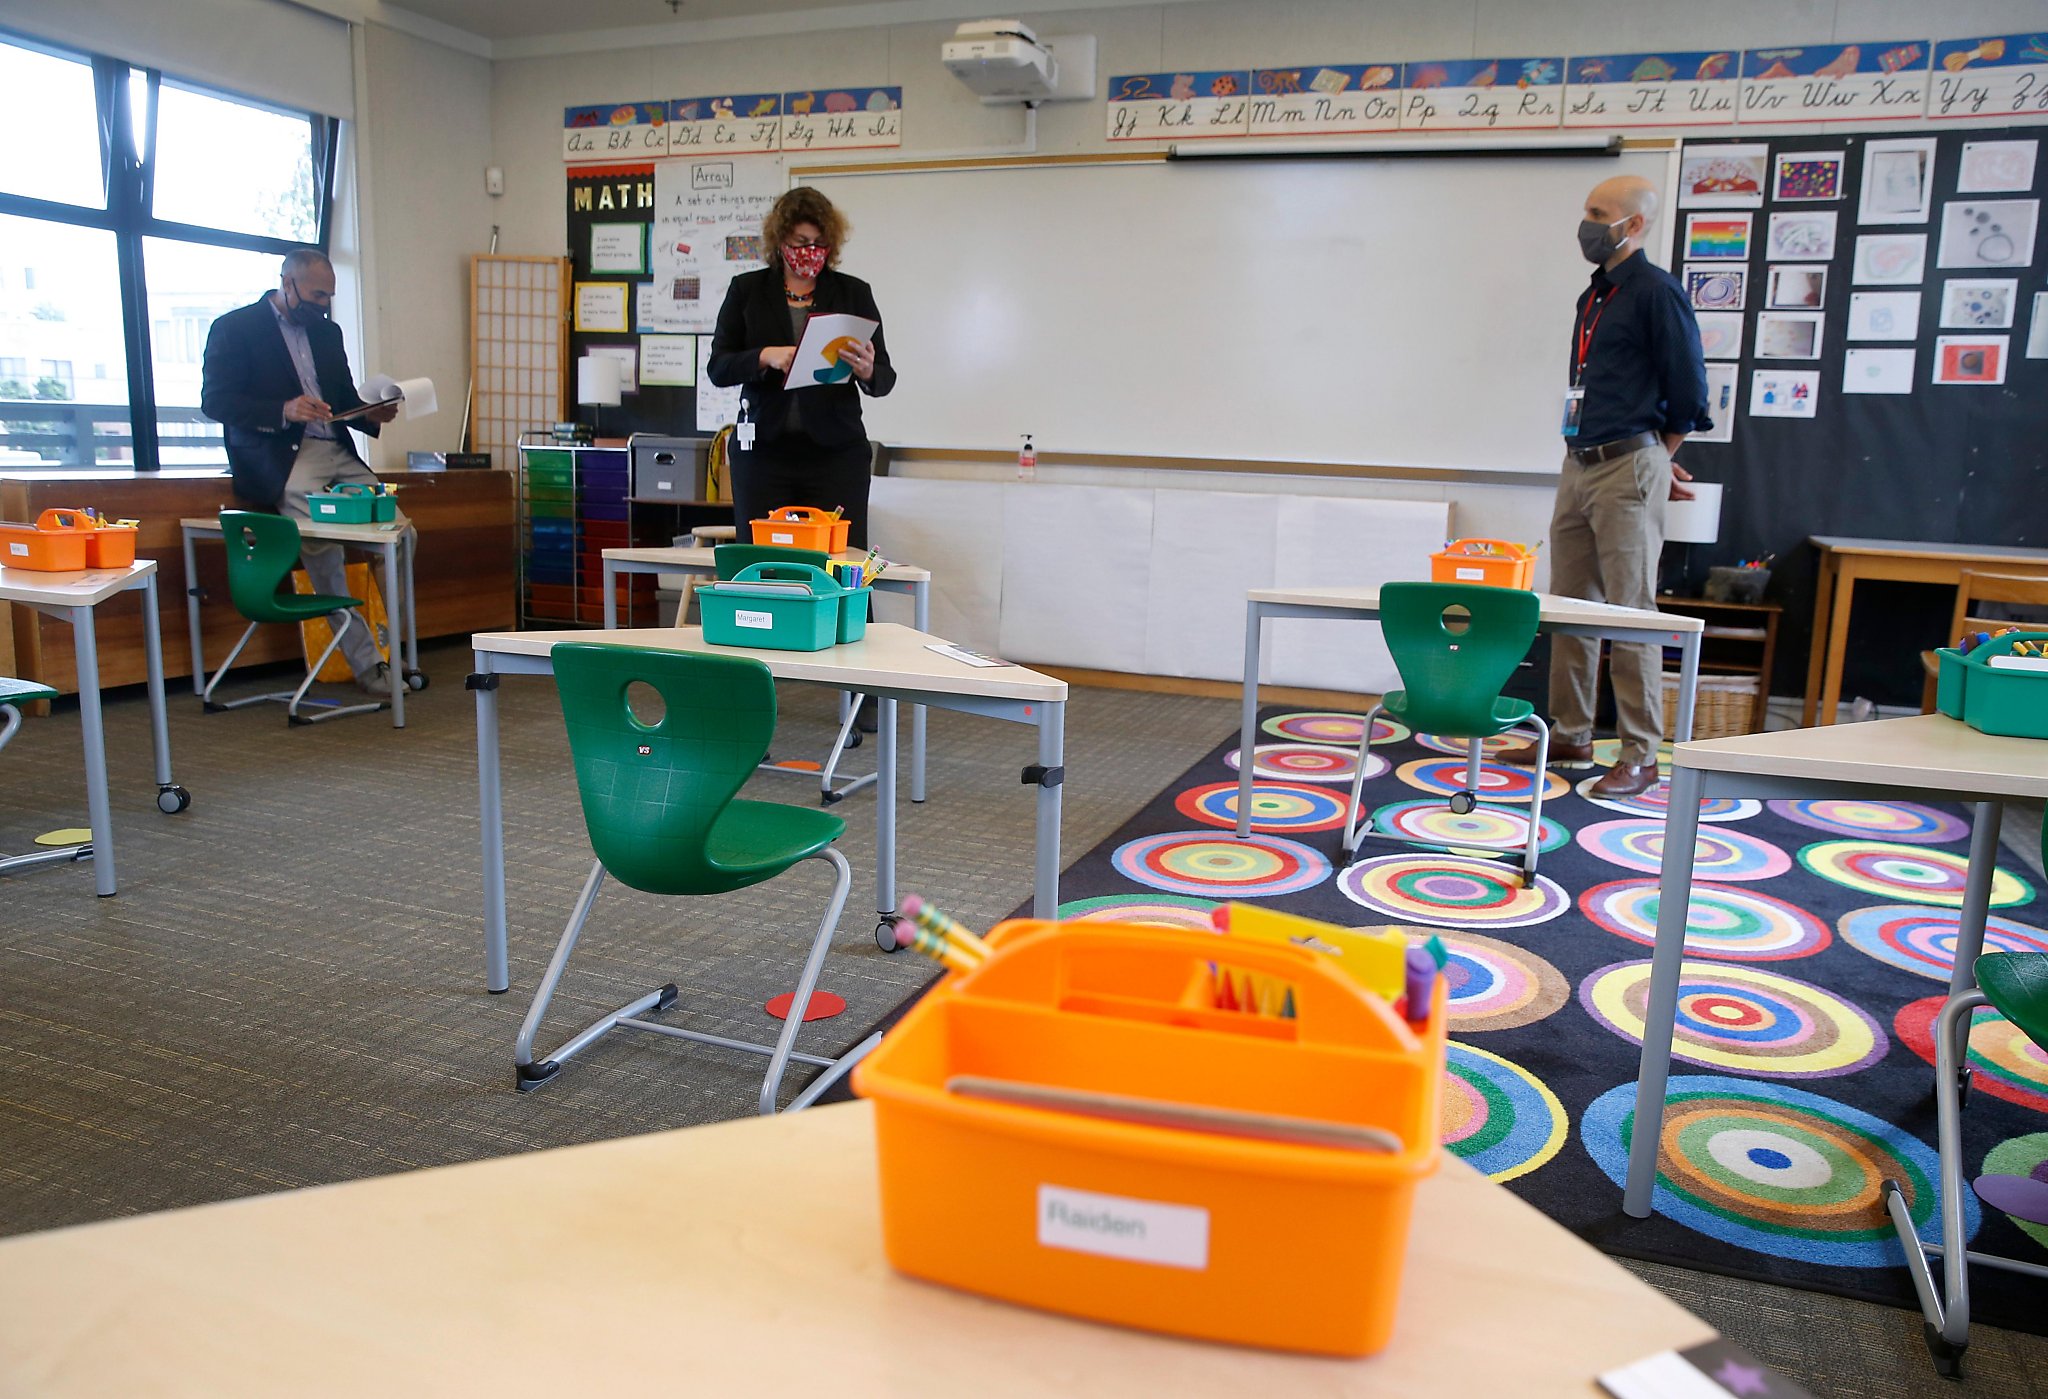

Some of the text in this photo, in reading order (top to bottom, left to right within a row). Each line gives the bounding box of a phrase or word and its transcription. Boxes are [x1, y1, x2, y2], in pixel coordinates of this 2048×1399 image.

[1158, 104, 1194, 126] Kk
[1210, 103, 1245, 125] Ll
[1252, 101, 1305, 123] Mm
[1315, 99, 1356, 120] Nn
[1365, 97, 1397, 119] Oo
[1406, 95, 1437, 126] Pp
[1518, 92, 1554, 116] Rr
[1569, 91, 1606, 114] Ss
[1627, 88, 1666, 113] Tt
[1689, 87, 1732, 111] Uu
[1744, 84, 1788, 109] Vv
[1802, 82, 1860, 107] Ww
[1869, 79, 1921, 106] Xx
[1940, 78, 1989, 114] Yy
[568, 132, 594, 151] Aa
[607, 130, 632, 149] Bb
[644, 129, 664, 148] Cc
[673, 126, 701, 145] Dd
[714, 124, 736, 144] Ee
[751, 121, 777, 149] Ff
[828, 118, 856, 138] Hh
[696, 167, 731, 188] Array
[574, 182, 653, 212] MATH
[688, 193, 702, 206] set
[706, 193, 716, 206] of
[737, 613, 765, 624] Margaret
[1046, 1199, 1147, 1238] Raiden
